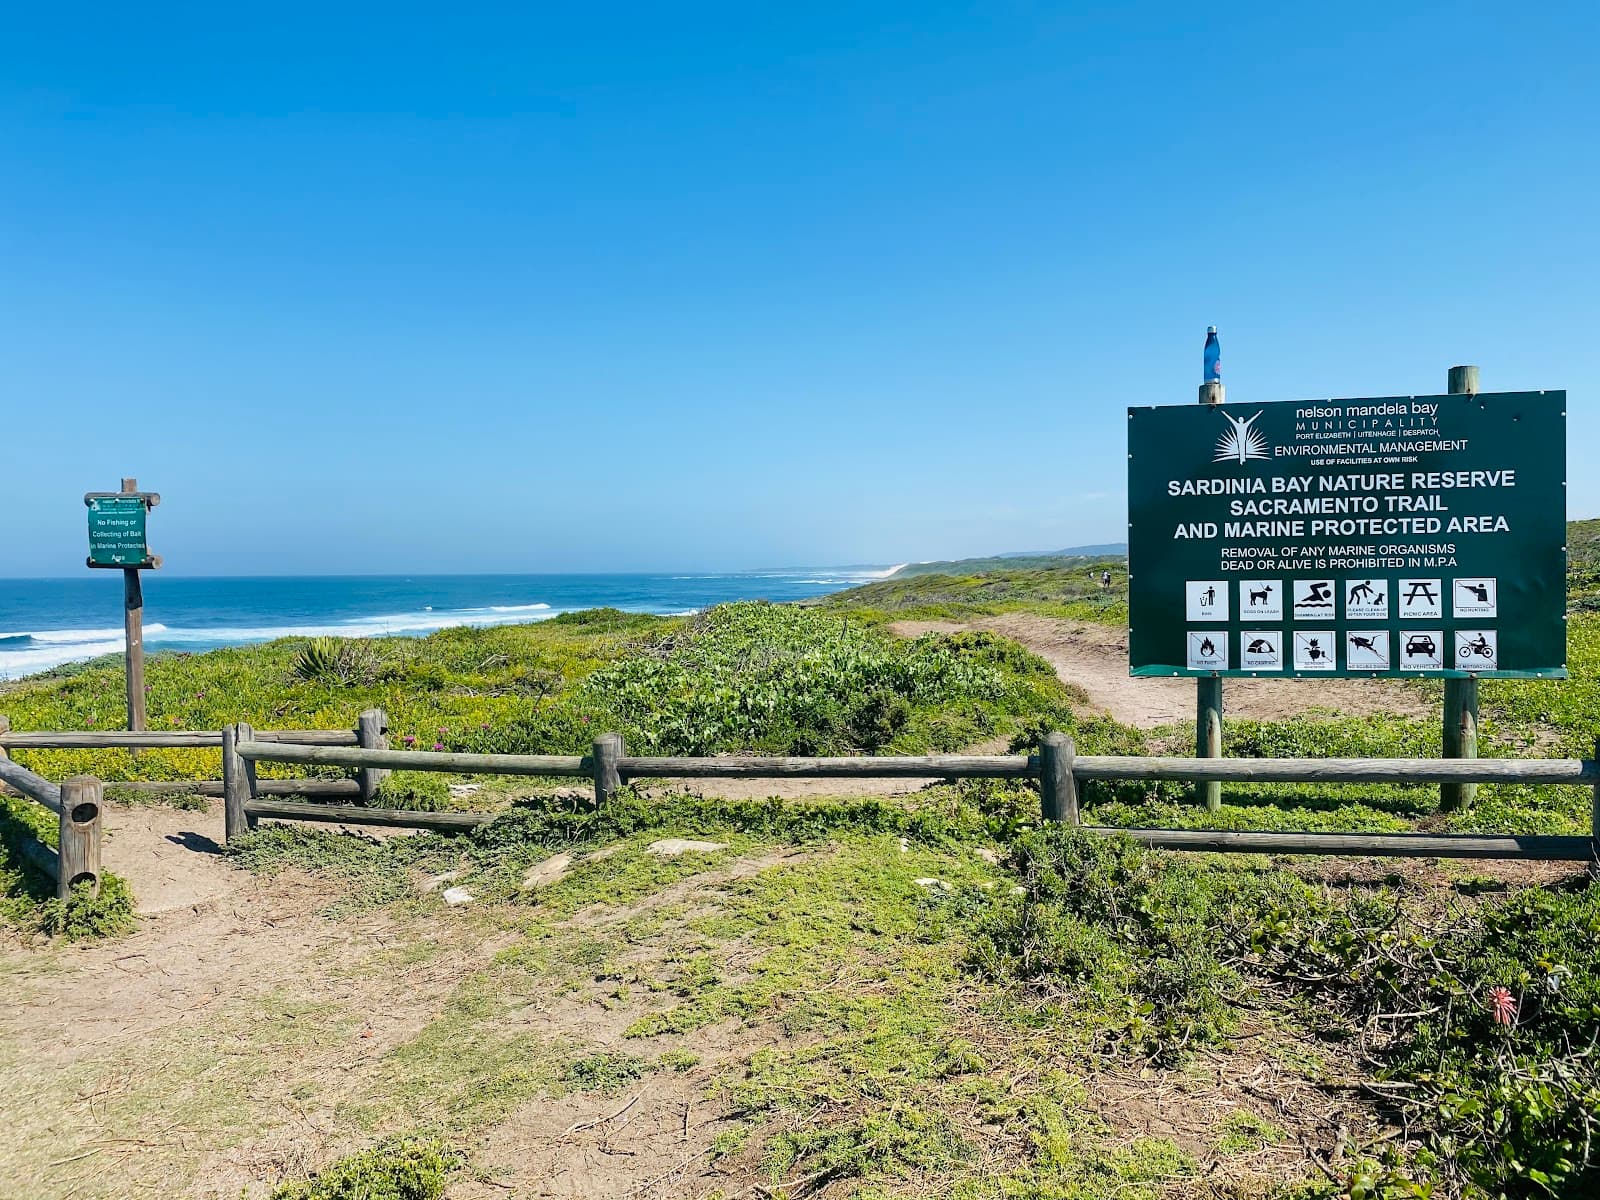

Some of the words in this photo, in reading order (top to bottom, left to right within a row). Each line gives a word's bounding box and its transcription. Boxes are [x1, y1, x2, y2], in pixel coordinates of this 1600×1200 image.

[1296, 406, 1341, 418] nelson
[1346, 404, 1407, 416] mandela
[1412, 402, 1438, 416] bay
[1296, 417, 1437, 430] MUNICIPALITY
[1275, 443, 1376, 456] ENVIRONMENTAL
[1380, 440, 1468, 453] MANAGEMENT
[1168, 478, 1266, 496] SARDINIA
[1272, 476, 1313, 493] BAY
[1319, 473, 1405, 491] NATURE
[1412, 470, 1515, 489] RESERVE
[1231, 496, 1378, 515] SACRAMENTO
[1385, 495, 1448, 512] TRAIL
[1174, 523, 1217, 539] AND
[1224, 521, 1304, 537] MARINE
[1312, 518, 1441, 536] PROTECTED
[1447, 516, 1510, 533] AREA
[1221, 548, 1278, 557] REMOVAL
[1281, 547, 1298, 556] OF
[1300, 546, 1325, 556] ANY
[1329, 545, 1375, 556] MARINE
[1379, 544, 1455, 555] ORGANISMS
[1221, 561, 1254, 570] DEAD
[1257, 560, 1275, 569] OR
[1278, 560, 1311, 569] ALIVE
[1315, 560, 1326, 568] IS
[1330, 558, 1404, 568] PROHIBITED
[1409, 558, 1420, 567] IN
[1424, 557, 1457, 567] M.P.A
